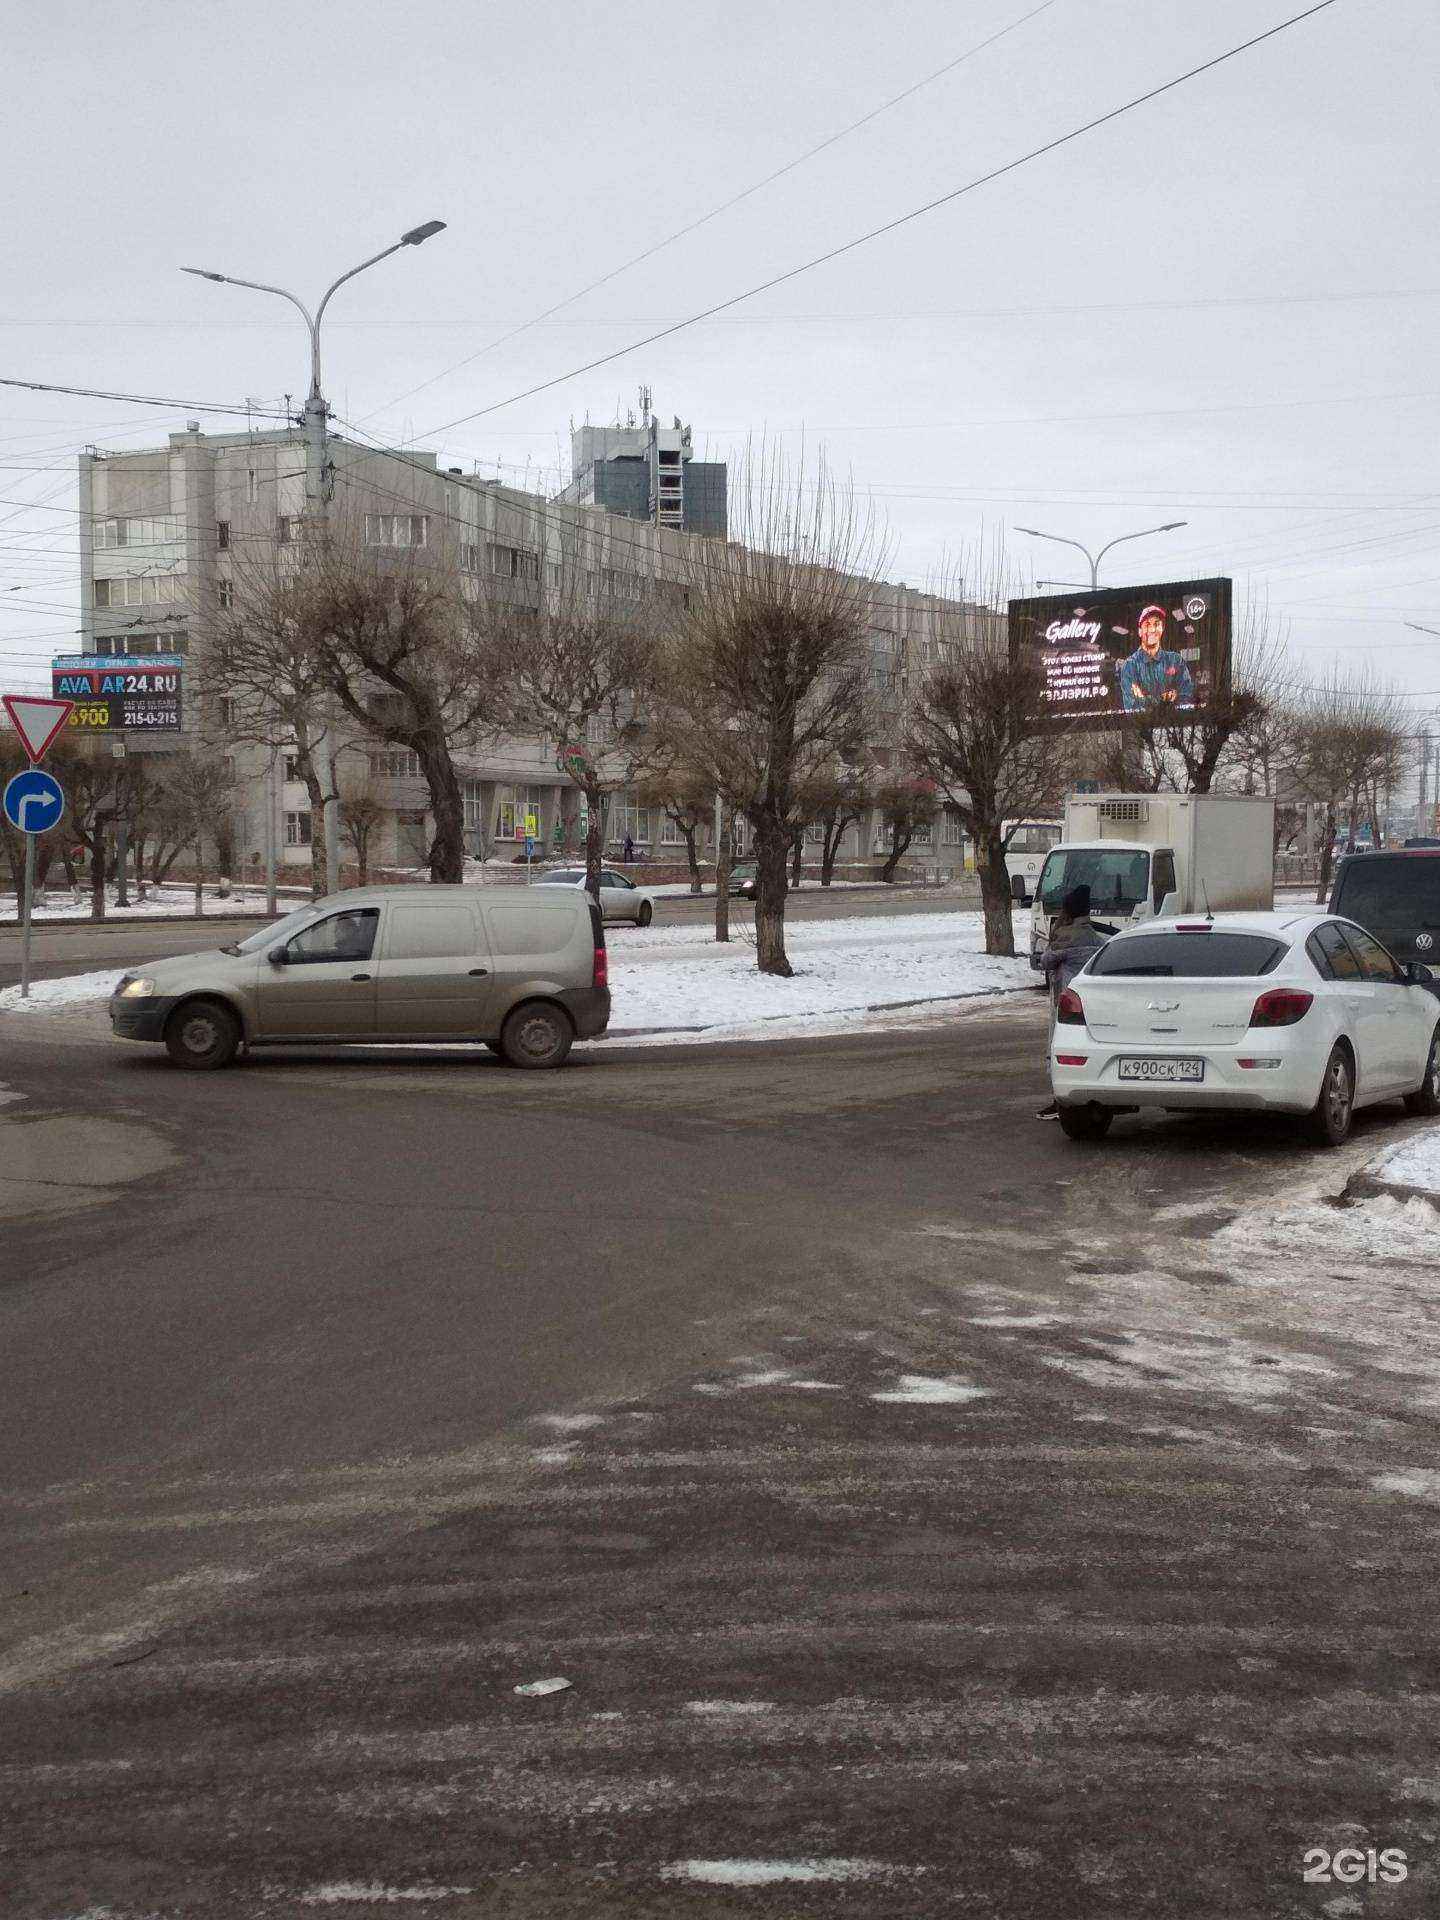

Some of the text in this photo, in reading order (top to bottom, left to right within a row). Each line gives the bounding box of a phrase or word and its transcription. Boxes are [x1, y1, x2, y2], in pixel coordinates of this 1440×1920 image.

[1045, 619, 1102, 643] Gallery
[124, 711, 177, 725] 215-0-215
[1124, 1060, 1200, 1076] К900СК 124
